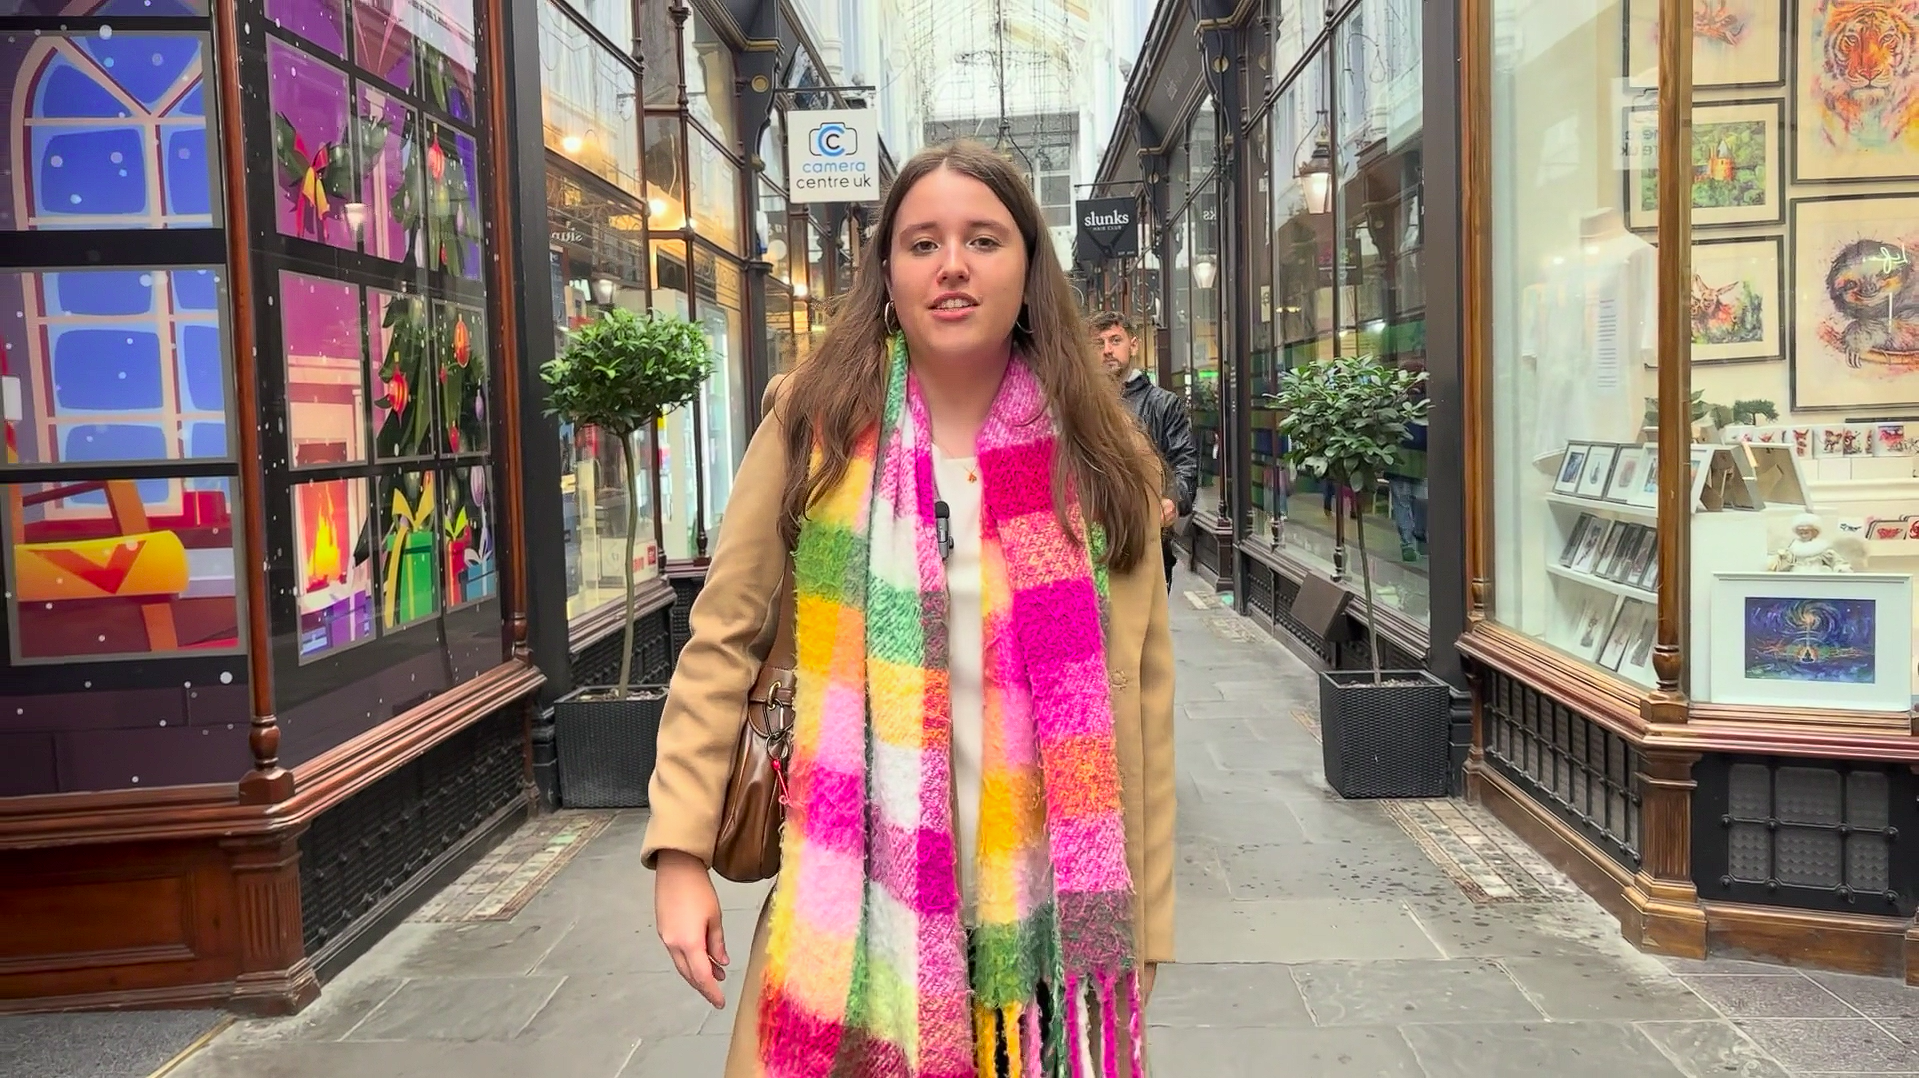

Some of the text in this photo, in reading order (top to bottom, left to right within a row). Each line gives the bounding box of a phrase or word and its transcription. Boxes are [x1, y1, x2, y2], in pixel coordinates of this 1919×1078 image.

[802, 161, 866, 173] camera
[796, 173, 872, 189] centre uk
[1084, 209, 1130, 227] slunks
